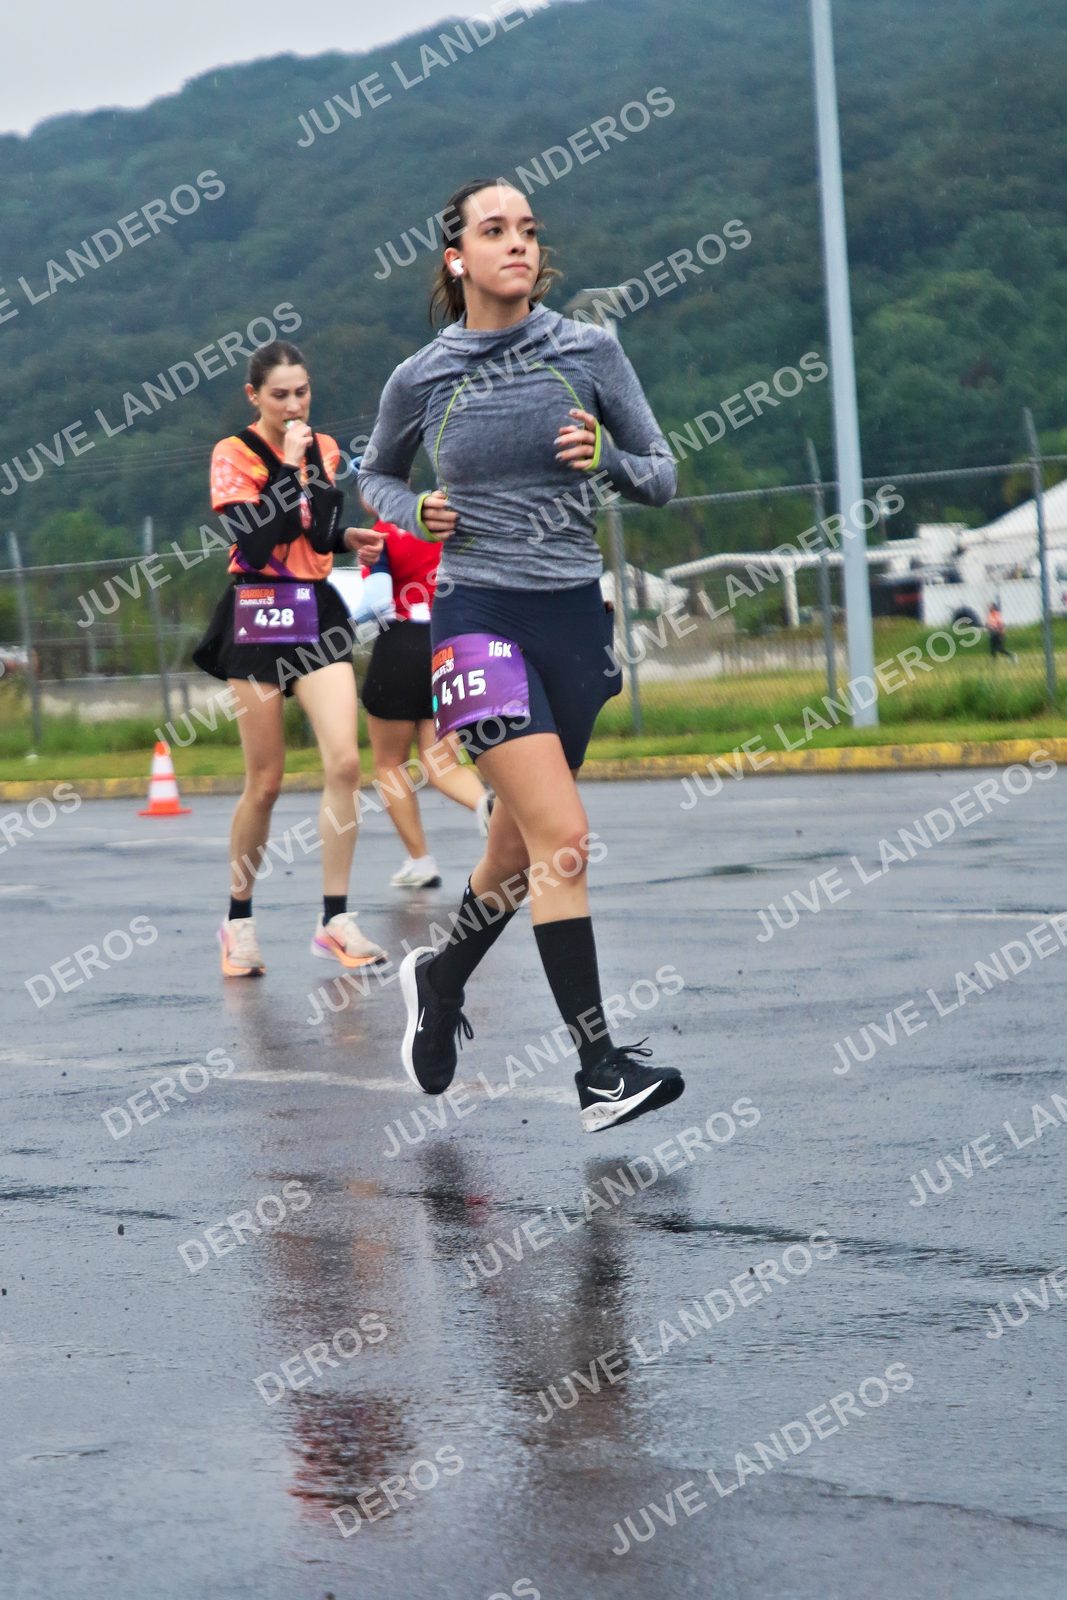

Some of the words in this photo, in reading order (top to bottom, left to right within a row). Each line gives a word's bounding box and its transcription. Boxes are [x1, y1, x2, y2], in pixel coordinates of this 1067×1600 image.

[255, 608, 295, 627] 428
[489, 641, 512, 658] 16K
[442, 669, 486, 705] 415
